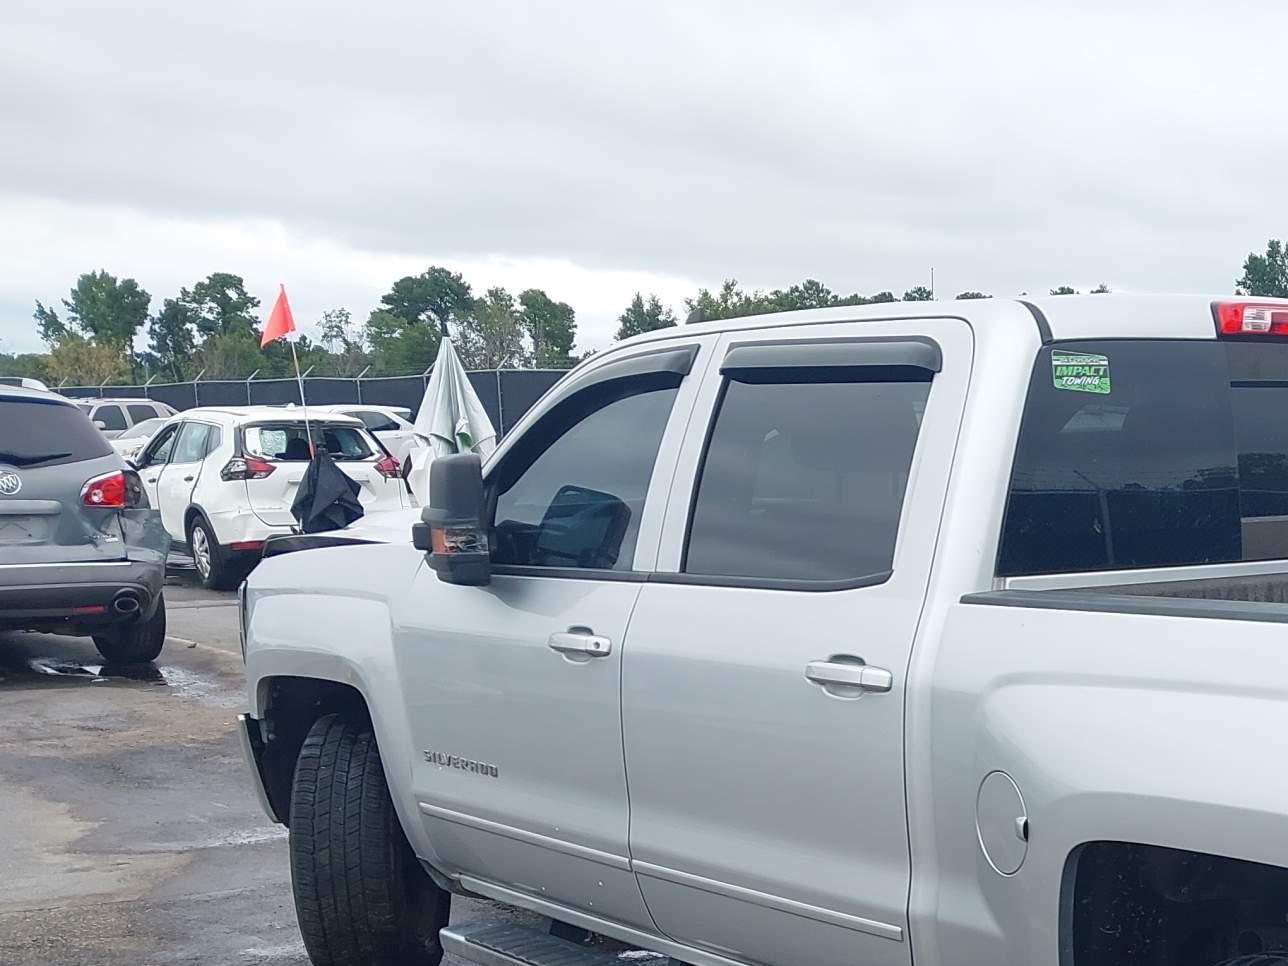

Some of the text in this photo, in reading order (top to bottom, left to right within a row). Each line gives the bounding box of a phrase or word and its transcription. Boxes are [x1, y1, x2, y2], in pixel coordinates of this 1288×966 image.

[1055, 365, 1107, 376] IMPACT
[1061, 376, 1100, 385] TOWING
[423, 749, 499, 778] SILVERADO
